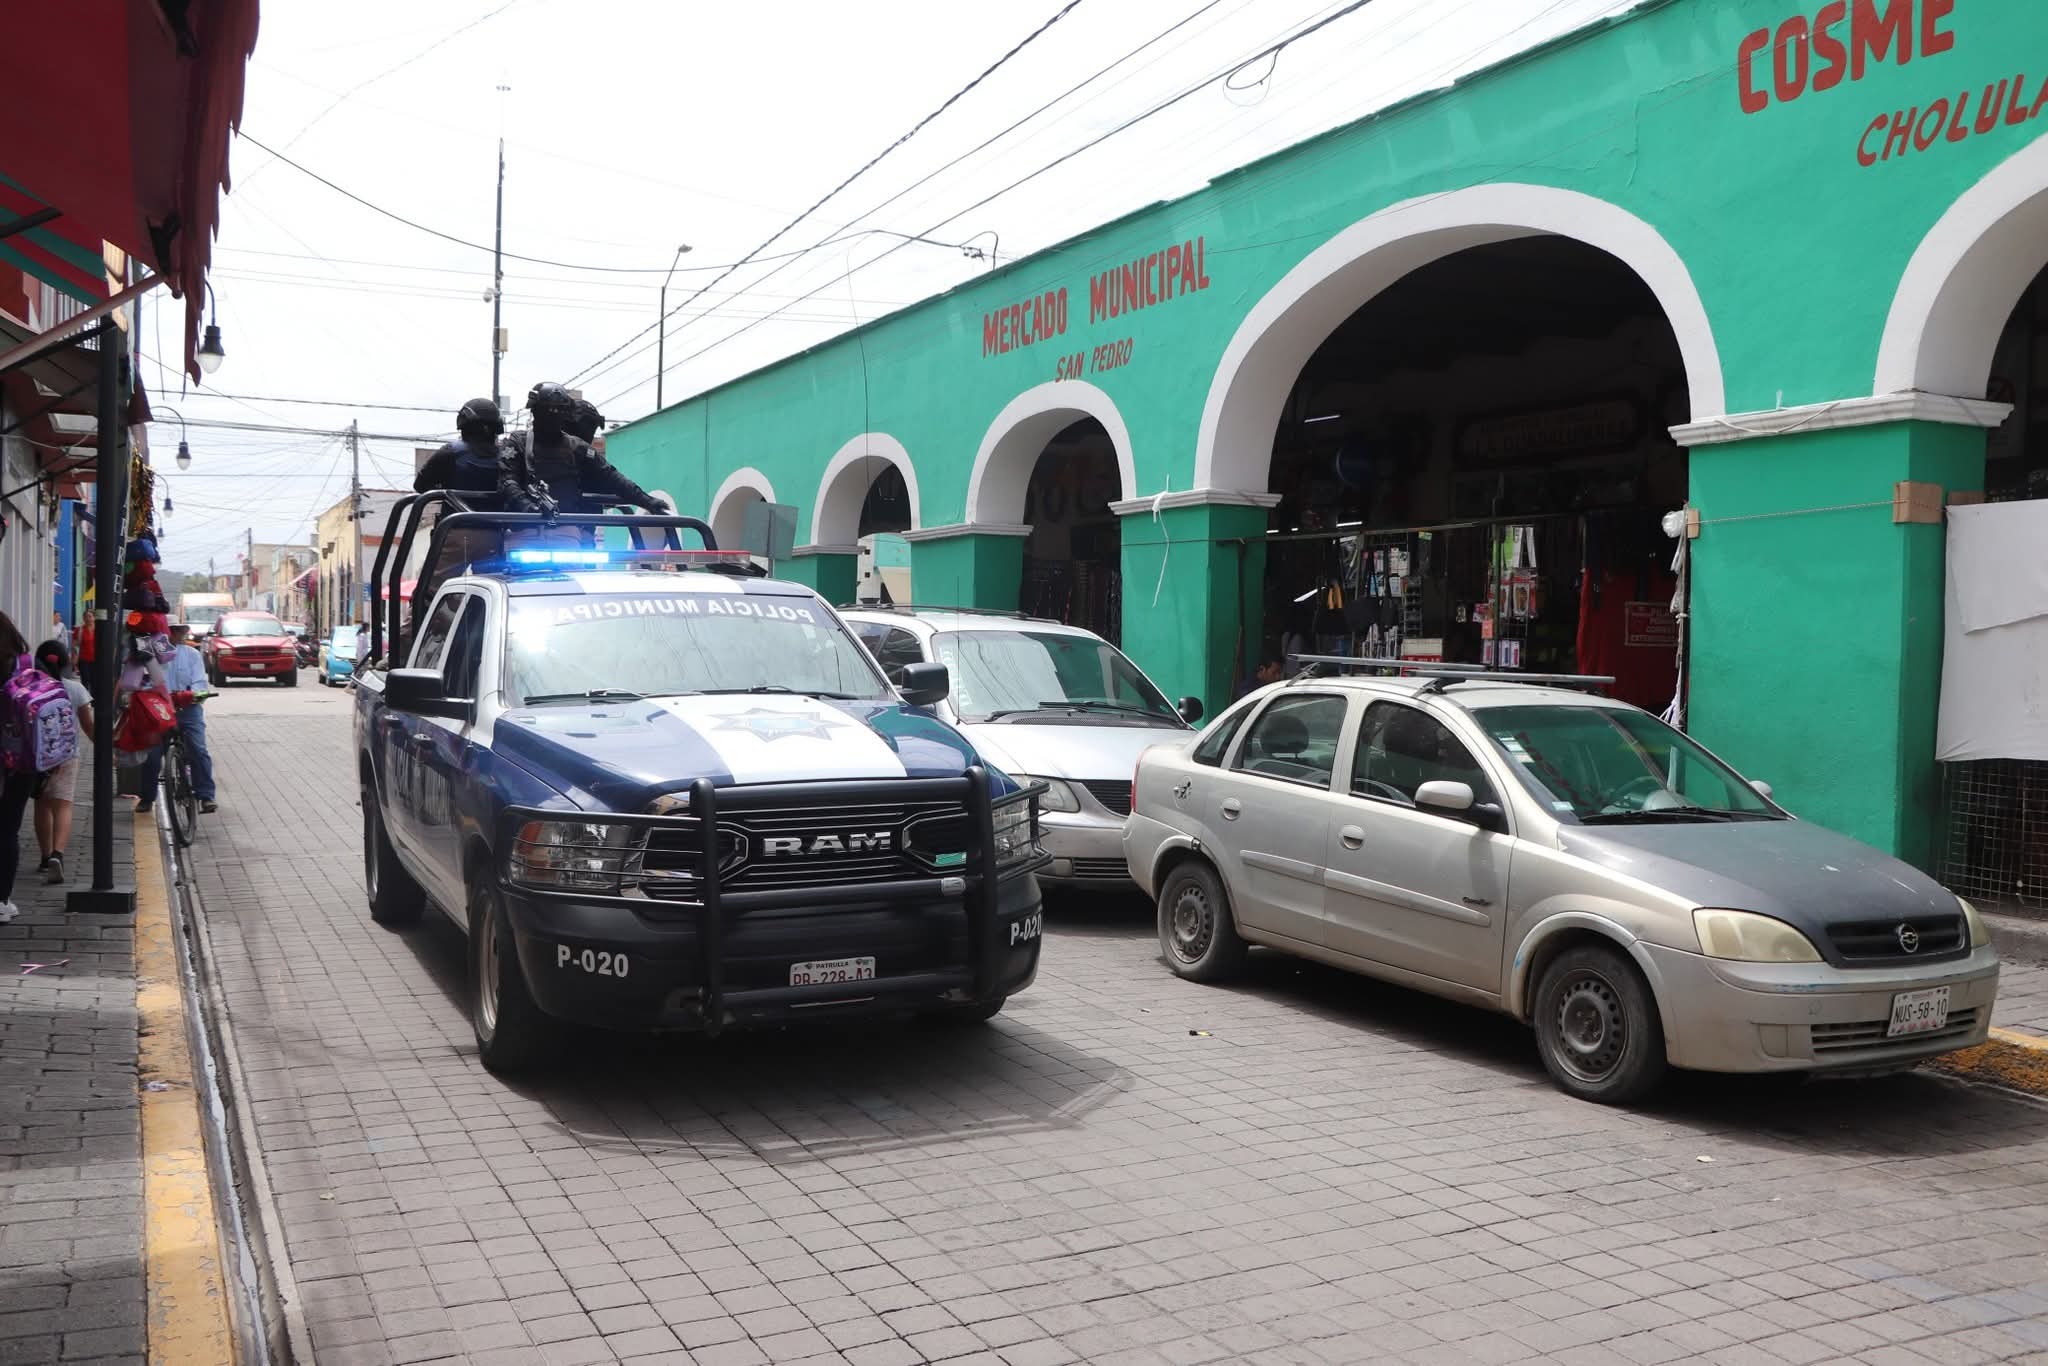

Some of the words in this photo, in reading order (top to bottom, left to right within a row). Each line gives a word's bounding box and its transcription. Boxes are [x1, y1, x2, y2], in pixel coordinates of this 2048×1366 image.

[1738, 0, 1954, 114] COSME
[983, 287, 1068, 358] MERCADO
[1090, 236, 1210, 324] MUNICIPAL
[1055, 352, 1085, 383] SAN
[1091, 337, 1133, 374] PEDRO
[763, 831, 891, 856] RAM
[1010, 914, 1042, 946] P-020
[557, 943, 629, 978] P-020
[815, 961, 849, 970] PATRULLA
[1893, 998, 1947, 1024] NUS-58-10
